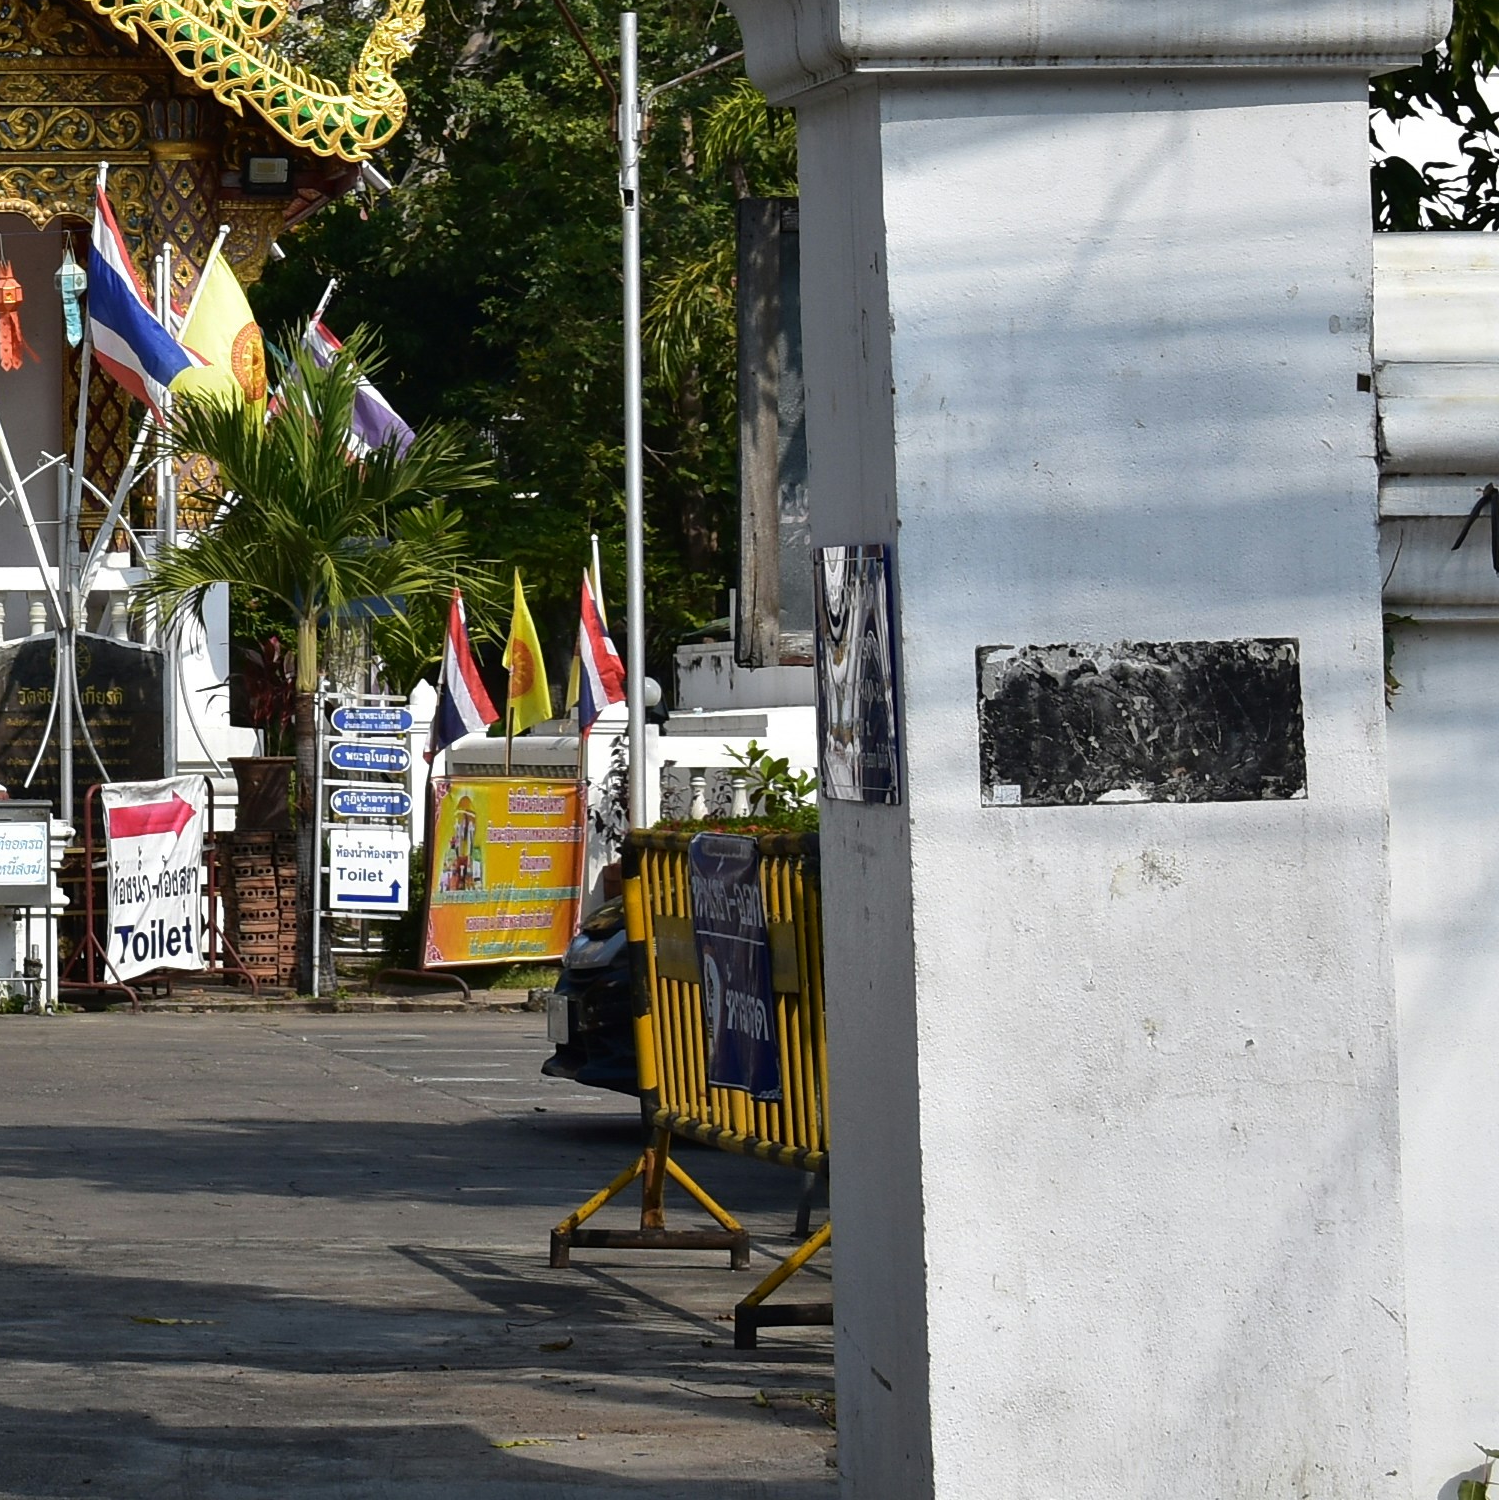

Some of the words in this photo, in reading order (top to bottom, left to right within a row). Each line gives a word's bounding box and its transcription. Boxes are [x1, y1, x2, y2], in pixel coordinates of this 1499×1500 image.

[336, 841, 404, 864] ห้องน้ำห้องสุขา
[336, 867, 384, 882] Toilet
[114, 916, 193, 964] Toilet
